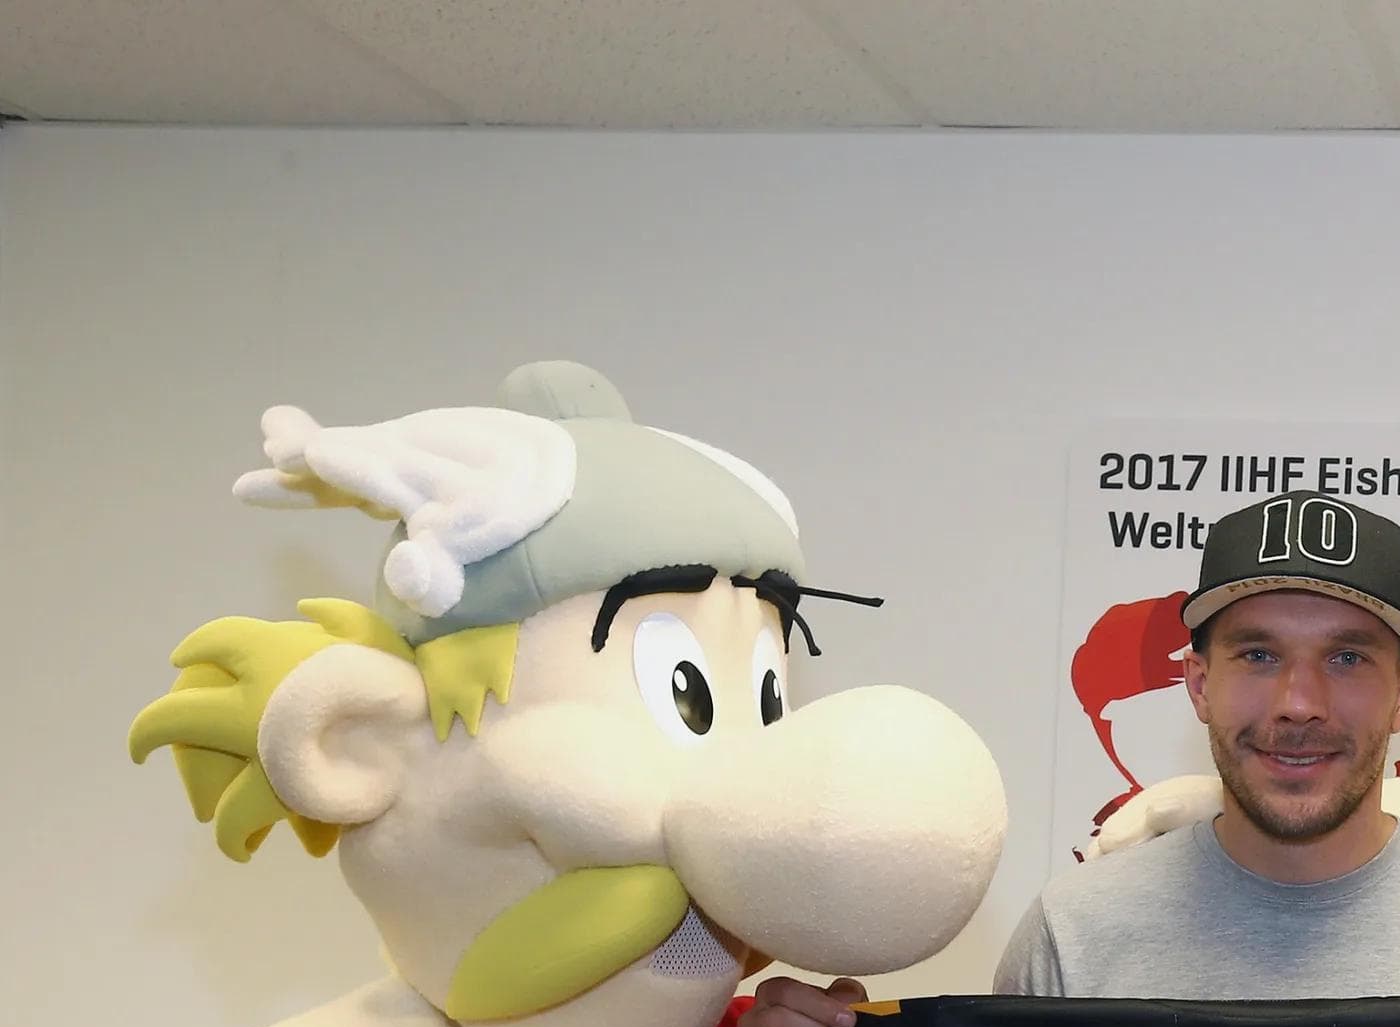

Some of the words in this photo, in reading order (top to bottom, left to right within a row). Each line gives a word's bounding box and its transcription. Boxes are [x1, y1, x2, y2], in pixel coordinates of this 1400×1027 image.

[1100, 453, 1208, 490] 2017
[1220, 455, 1306, 493] IIHF
[1258, 497, 1358, 567] 10
